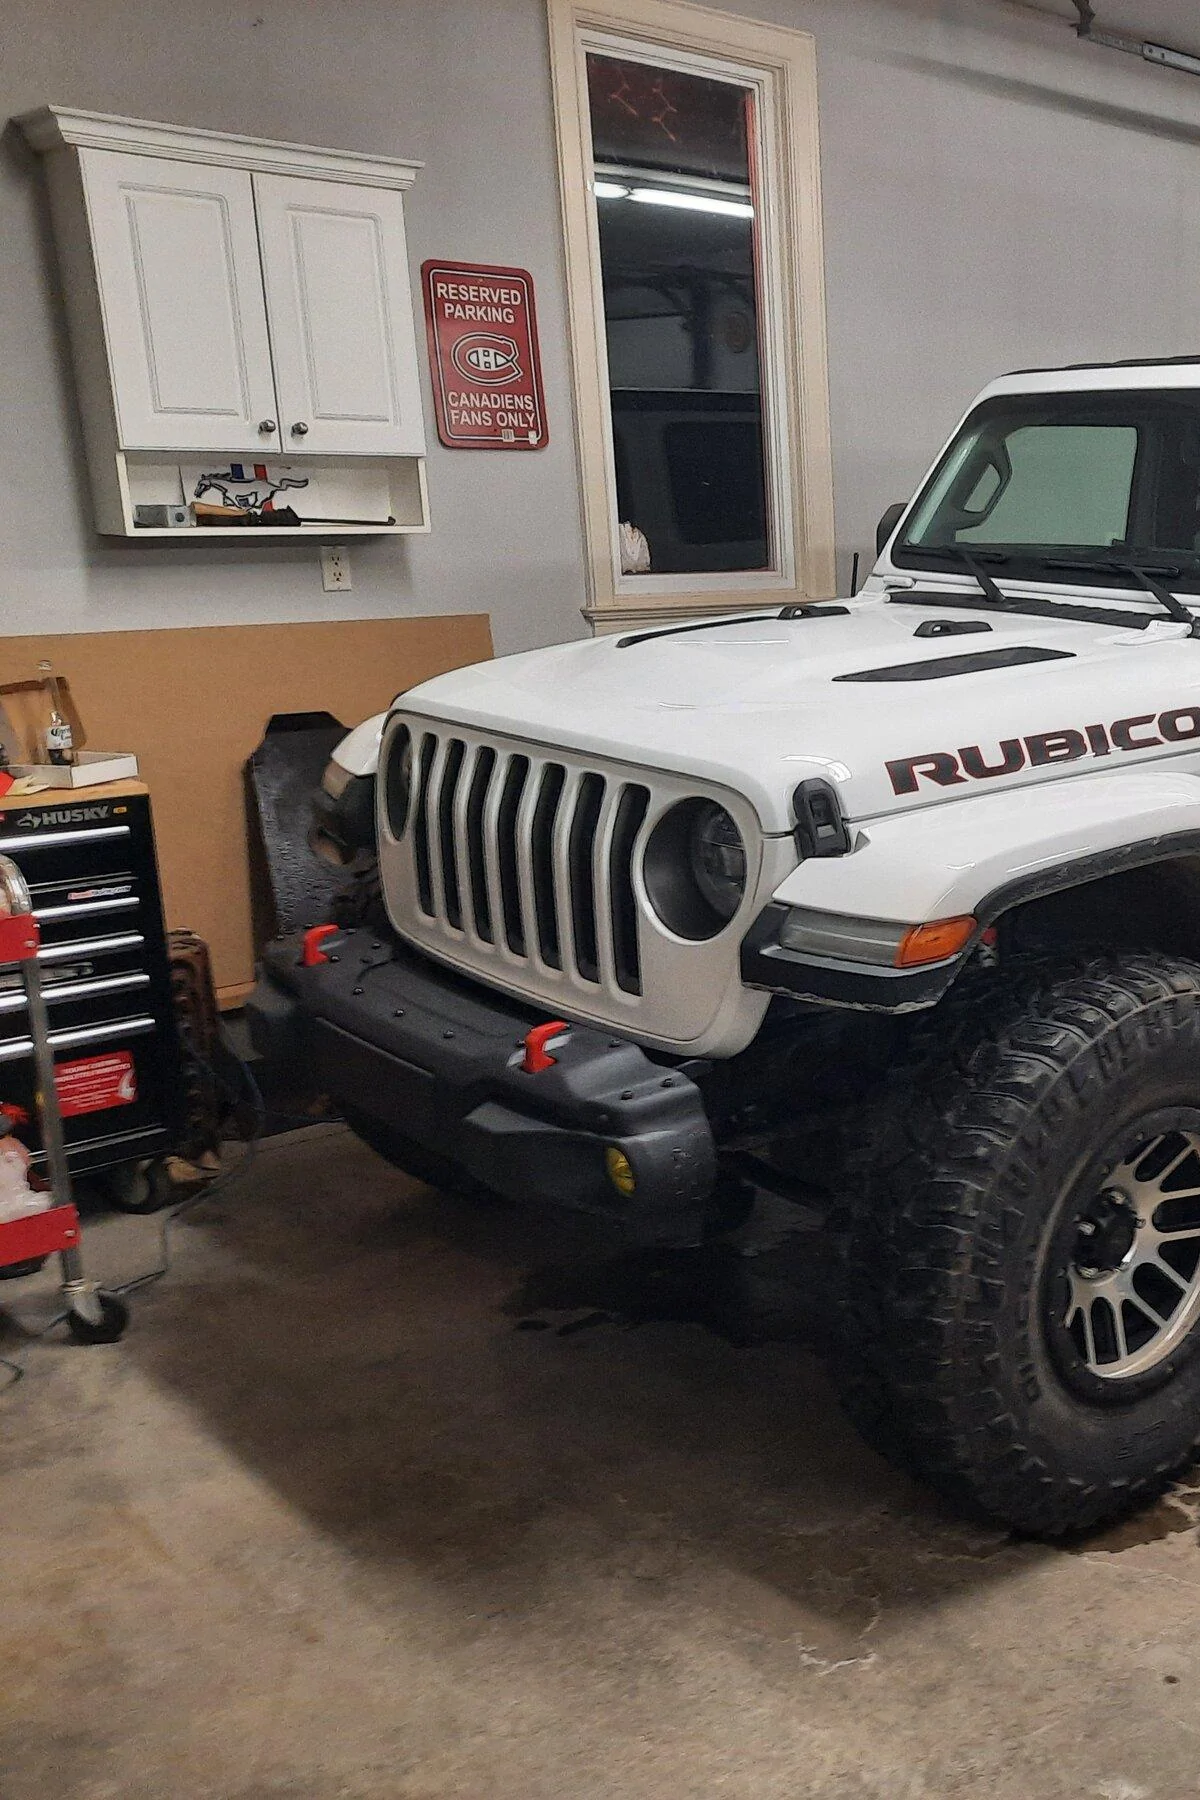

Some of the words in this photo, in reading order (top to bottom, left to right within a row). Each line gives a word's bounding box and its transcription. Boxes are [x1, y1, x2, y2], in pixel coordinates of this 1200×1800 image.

[436, 282, 521, 305] RESERVED
[444, 303, 515, 323] PARKING
[448, 391, 534, 411] CANADIENS
[451, 409, 492, 426] FANS
[496, 410, 535, 428] ONLY
[41, 805, 109, 825] HUSKY
